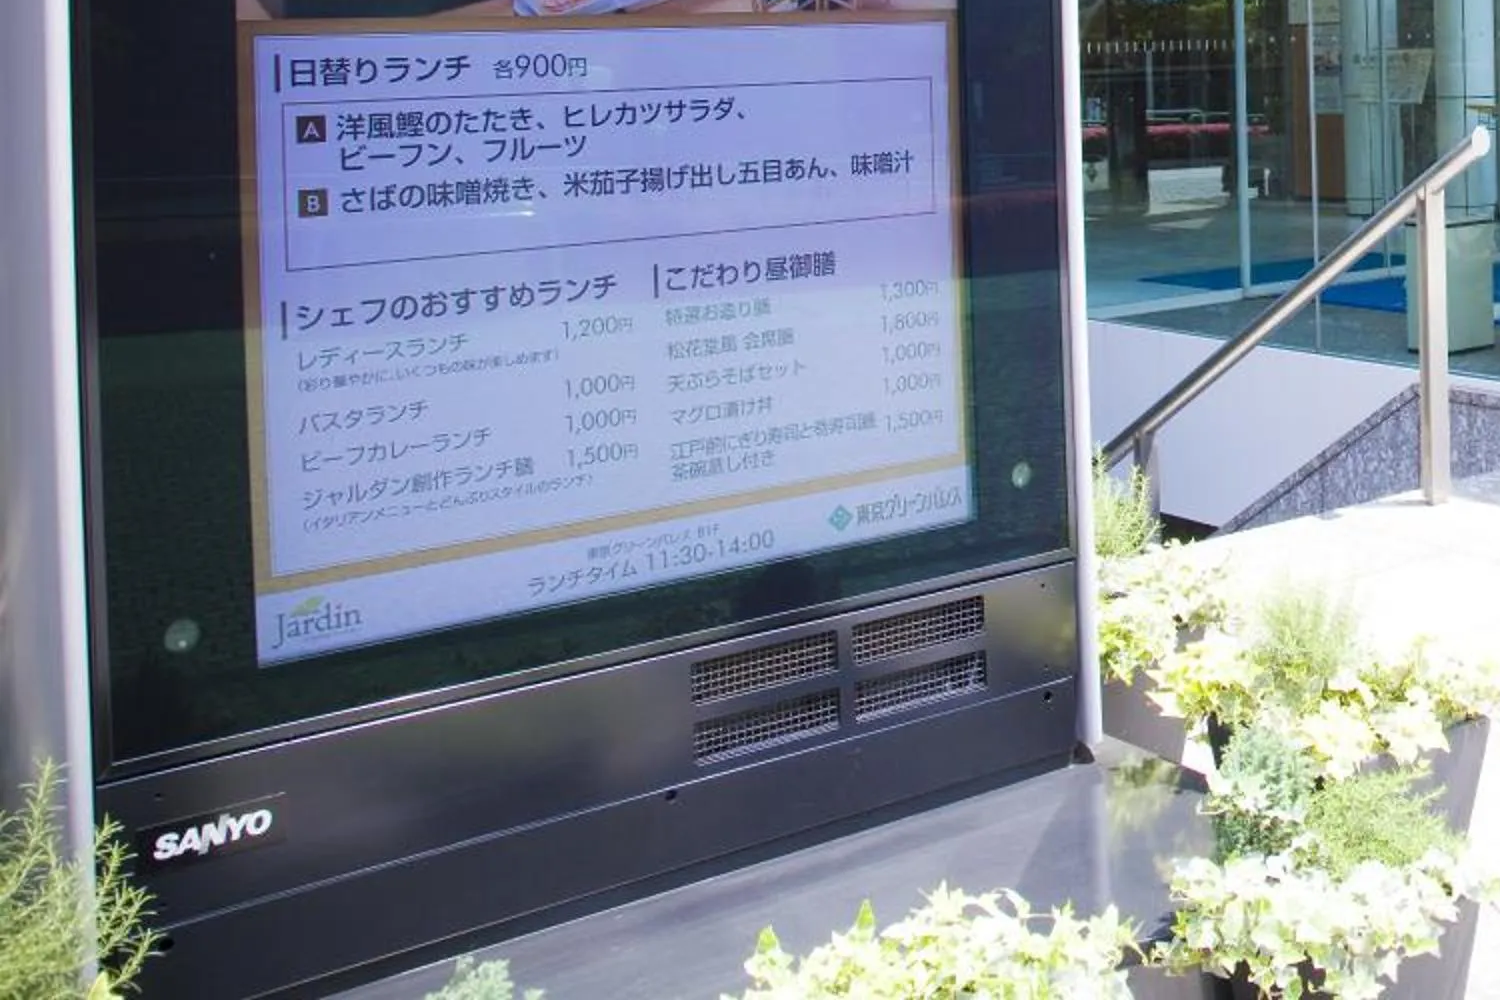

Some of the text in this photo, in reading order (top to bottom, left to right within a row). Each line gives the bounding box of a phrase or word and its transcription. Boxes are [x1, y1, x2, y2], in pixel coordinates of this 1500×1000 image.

[290, 53, 588, 88] 日替りランチ 各900円
[301, 119, 322, 140] A
[340, 134, 588, 172] ビーフン、フルーツ
[665, 250, 836, 292] こだわり昼御膳
[297, 273, 618, 332] シェフのおすすめランチ
[299, 315, 634, 371] レディースランチ 1,200円
[299, 373, 636, 435] パスタランチ 1,000円
[302, 408, 637, 473] ビーフカレーランチ 1,000円
[567, 442, 639, 469] 1,500円
[527, 529, 775, 597] ランチタイム 11:30-14:00
[271, 602, 364, 649] Jardin
[153, 808, 273, 860] SANYO
